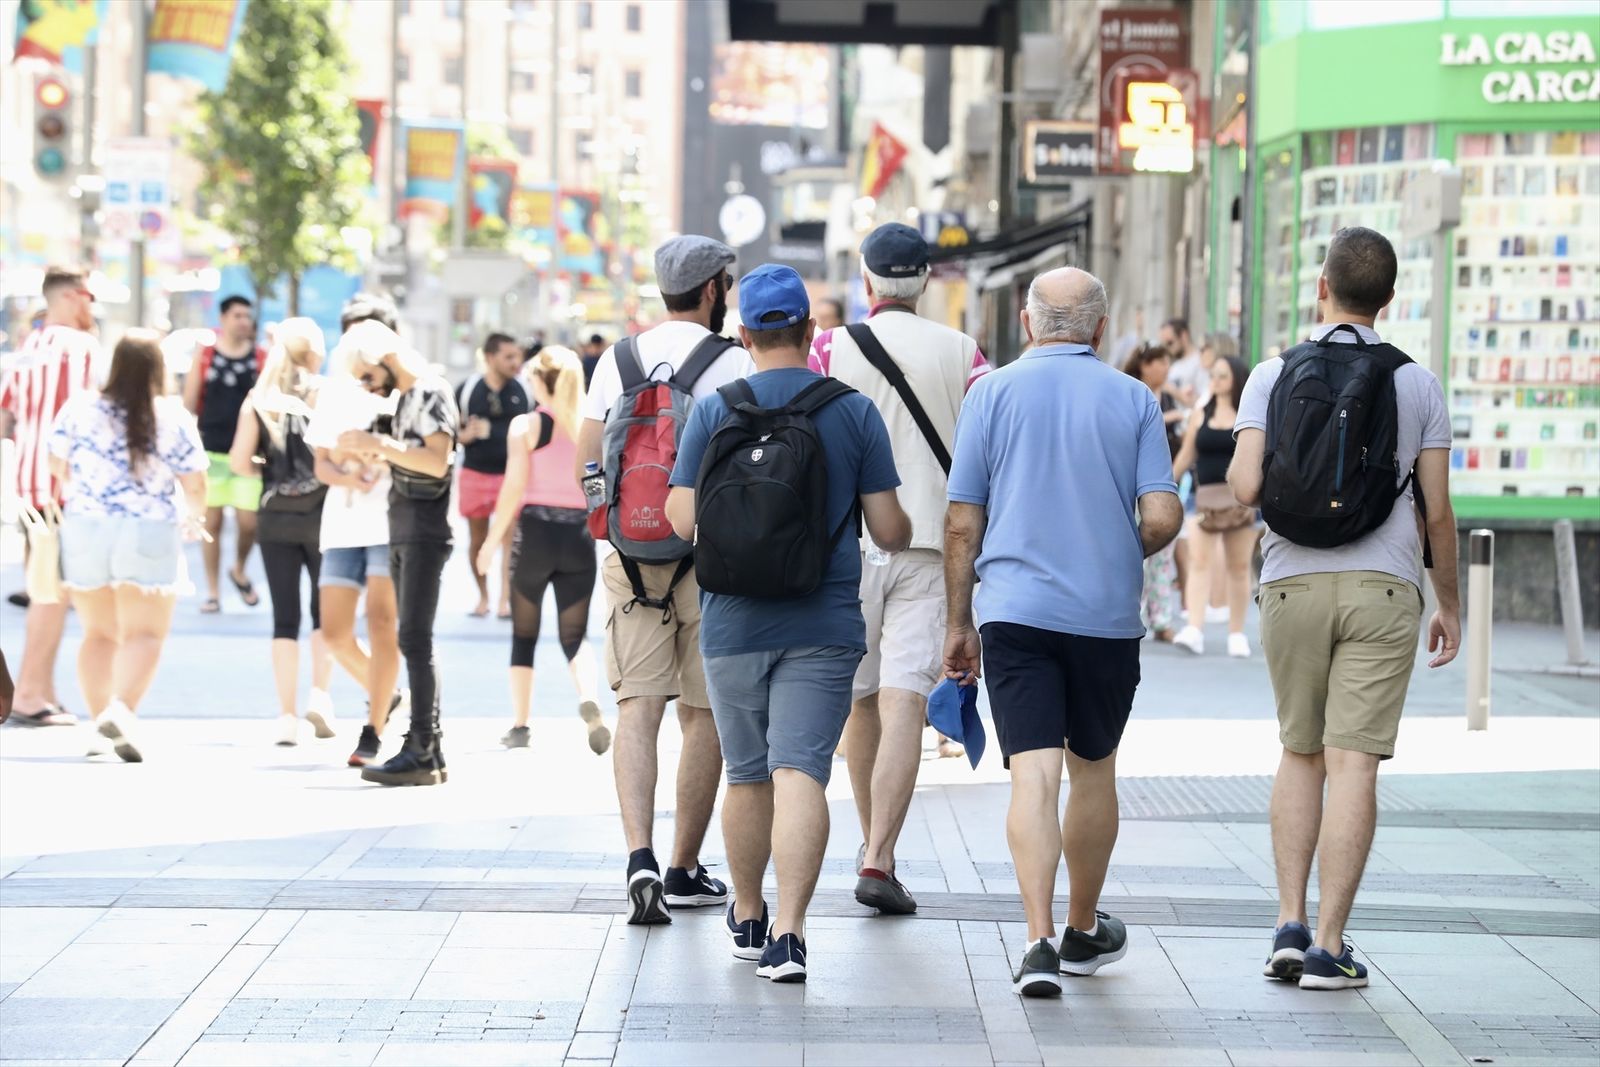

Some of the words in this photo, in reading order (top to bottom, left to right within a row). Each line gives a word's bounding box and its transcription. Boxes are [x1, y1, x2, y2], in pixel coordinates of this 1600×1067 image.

[1102, 19, 1121, 37] el
[1440, 32, 1492, 65] LA
[1494, 30, 1596, 64] CASA
[631, 520, 660, 528] SYSTEM
